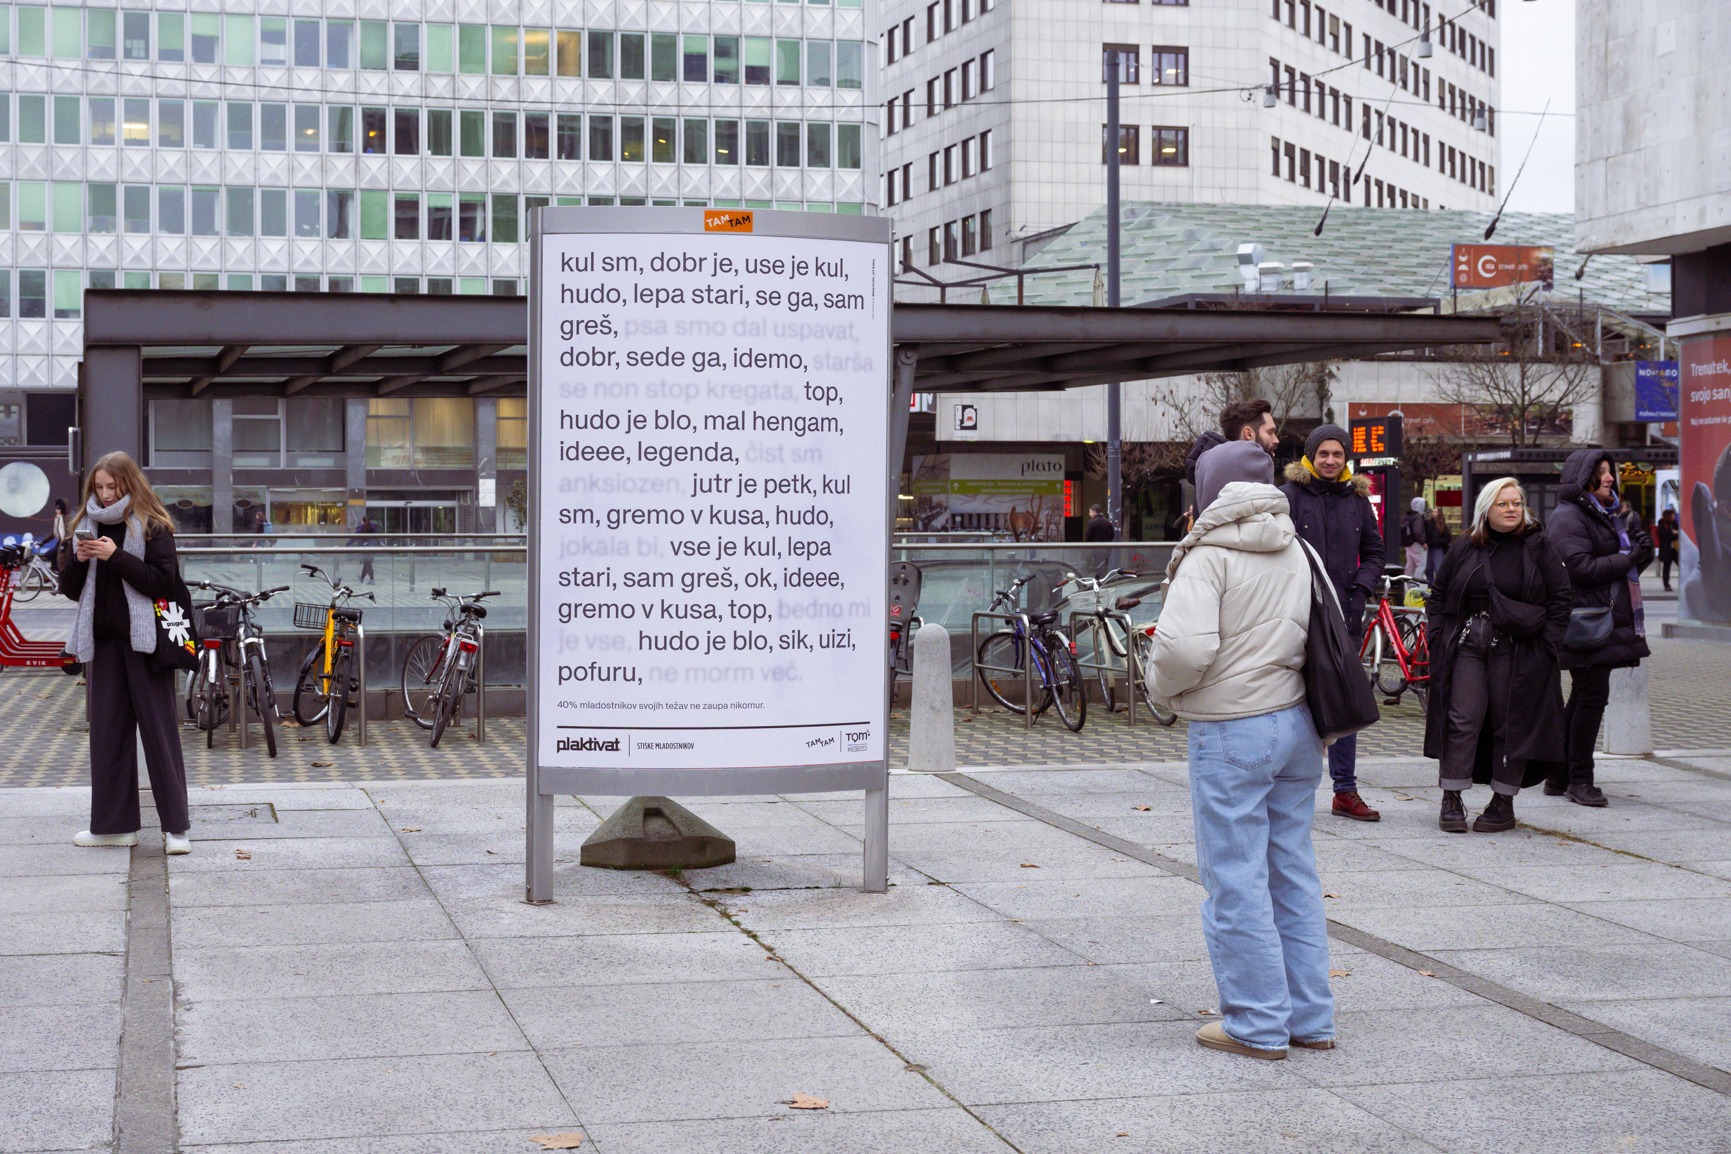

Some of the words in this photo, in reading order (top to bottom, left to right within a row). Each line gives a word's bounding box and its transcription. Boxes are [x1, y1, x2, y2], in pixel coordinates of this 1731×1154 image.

[561, 251, 595, 273] kul
[601, 255, 644, 276] sm,
[649, 251, 708, 273] dobr
[710, 252, 739, 278] je,
[745, 258, 786, 275] use
[788, 254, 809, 280] je
[814, 256, 849, 282] kul,
[560, 282, 627, 308] hudo,
[633, 282, 686, 309] lepa
[691, 284, 750, 309] stari,
[755, 289, 782, 307] se
[787, 290, 819, 313] ga,
[823, 292, 866, 312] sam
[559, 313, 618, 341] greš,
[559, 345, 620, 371] dobr,
[625, 346, 686, 368] sede
[691, 351, 727, 373] ga,
[733, 347, 808, 374] idemo,
[803, 380, 843, 407] top,
[1690, 387, 1711, 404] svojo
[560, 409, 621, 430] hudo
[624, 409, 648, 435] je
[654, 409, 698, 434] blo,
[704, 410, 746, 431] mal
[752, 410, 844, 438] hengam,
[559, 440, 631, 465] ideee,
[637, 440, 740, 468] legenda,
[1021, 459, 1062, 476] plato
[690, 472, 733, 498] jutr
[735, 473, 758, 499] je
[763, 473, 817, 499] petk,
[822, 473, 851, 495] kul
[558, 508, 601, 528] sm,
[606, 508, 685, 531] gremo
[690, 509, 704, 525] v
[709, 504, 770, 529] kusa,
[775, 504, 834, 529] hudo,
[669, 540, 711, 557] vse
[715, 535, 738, 561] je
[743, 535, 782, 561] kul,
[787, 535, 832, 562] lepa
[558, 566, 617, 592] stari,
[622, 571, 674, 588] sam
[680, 566, 739, 594] greš,
[744, 567, 778, 592] ok,
[783, 566, 845, 591] ideee,
[558, 602, 636, 624] gremo
[640, 603, 655, 619] v
[660, 598, 723, 623] kusa,
[727, 599, 773, 624] top,
[638, 629, 700, 651] hudo
[703, 630, 727, 656] je
[733, 629, 774, 654] blo,
[778, 629, 814, 653] sik,
[819, 627, 856, 652] uizi,
[558, 660, 643, 686] pofuru,
[557, 700, 578, 709] 40%
[579, 700, 637, 710] mladostnikov
[638, 701, 664, 711] svojih
[665, 701, 689, 710] težav
[702, 703, 729, 712] zaupa
[730, 701, 765, 710] nikomur.
[556, 736, 621, 754] plaktivat
[637, 742, 654, 750] STISKE
[655, 742, 695, 750] MLADOSTNIKOV
